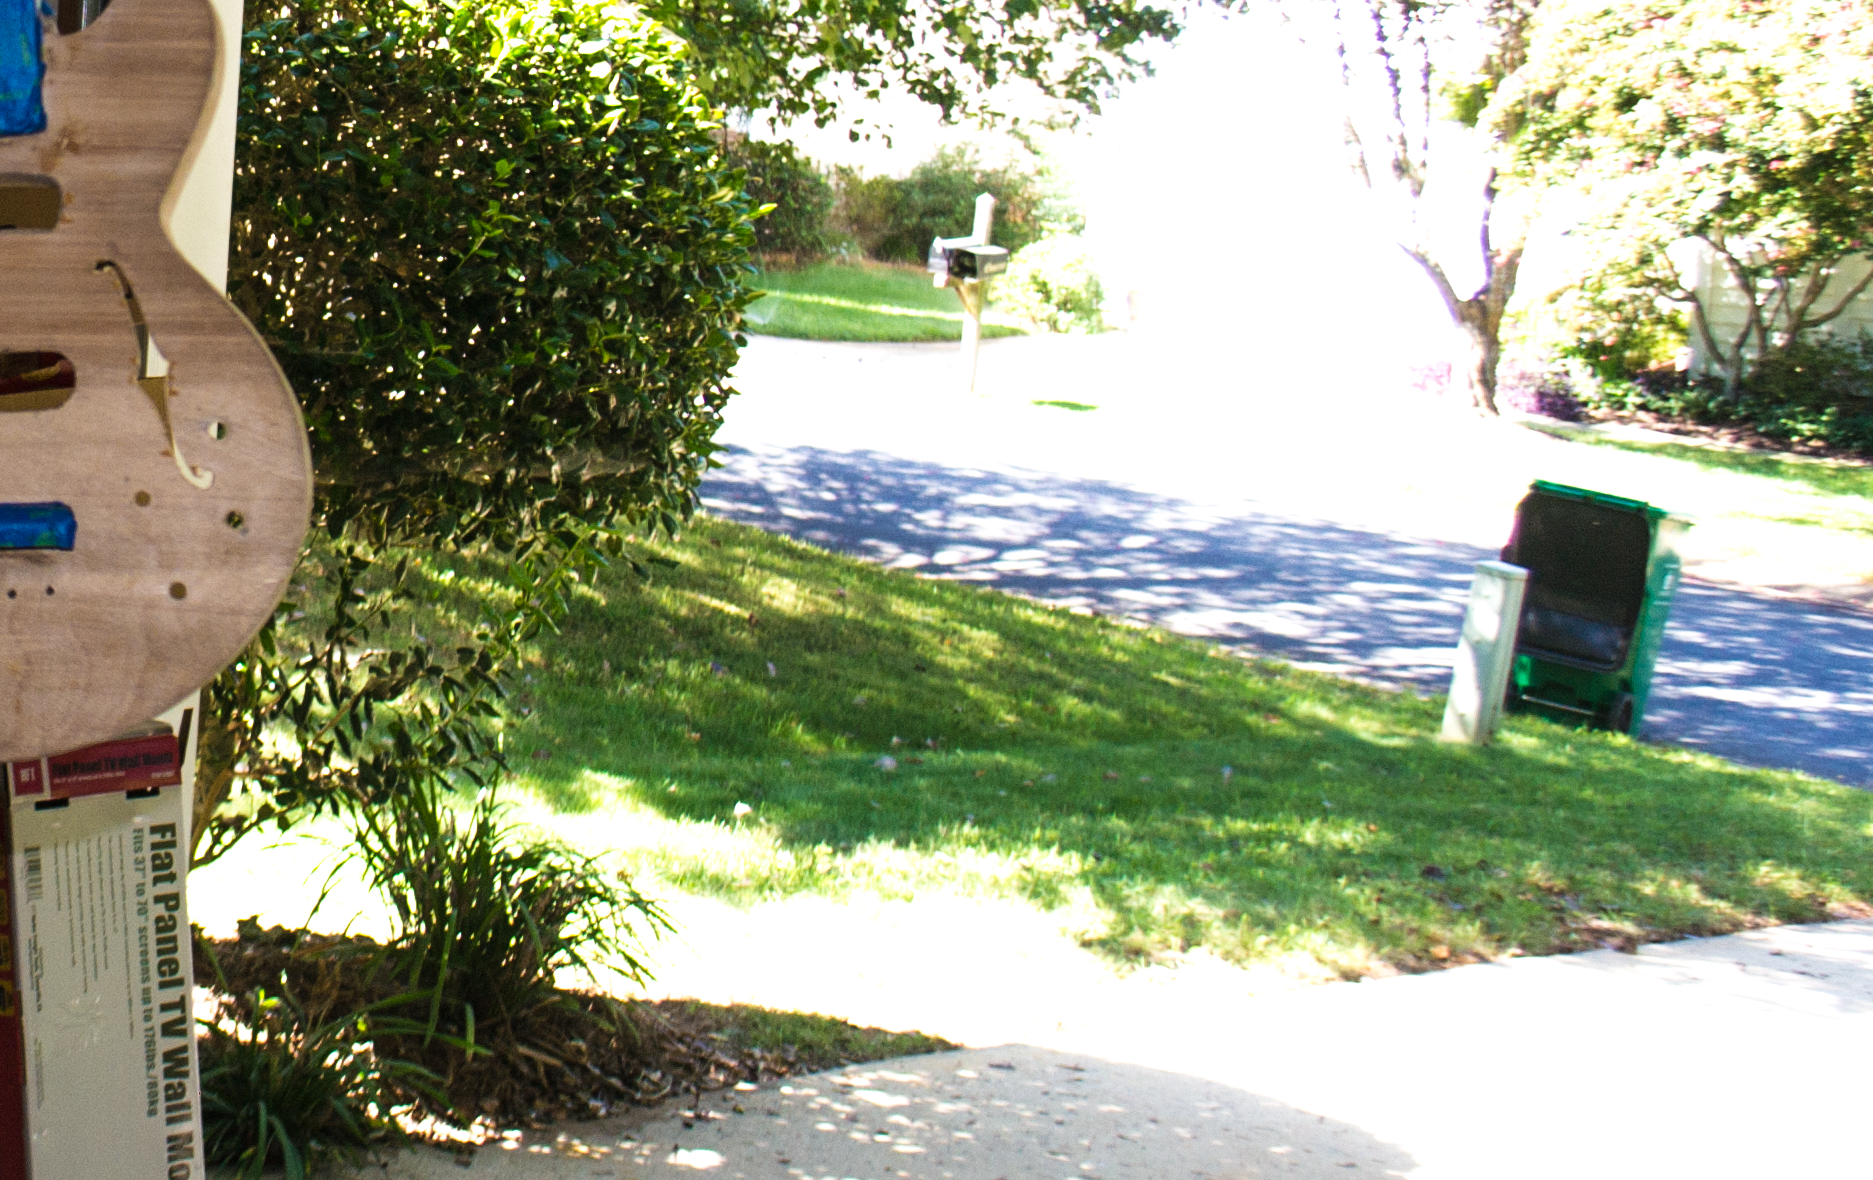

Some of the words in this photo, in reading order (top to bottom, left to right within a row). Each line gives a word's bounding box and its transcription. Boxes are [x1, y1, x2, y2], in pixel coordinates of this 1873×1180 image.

[73, 759, 102, 774] Panel
[103, 756, 116, 770] TV
[132, 827, 145, 854] Fits
[149, 822, 177, 888] Flat
[136, 882, 146, 898] to
[138, 925, 151, 984] screens
[153, 891, 185, 990] Panel
[141, 986, 152, 1006] up
[143, 1007, 154, 1023] to
[159, 994, 188, 1038] TV
[162, 1043, 193, 1126] Wall
